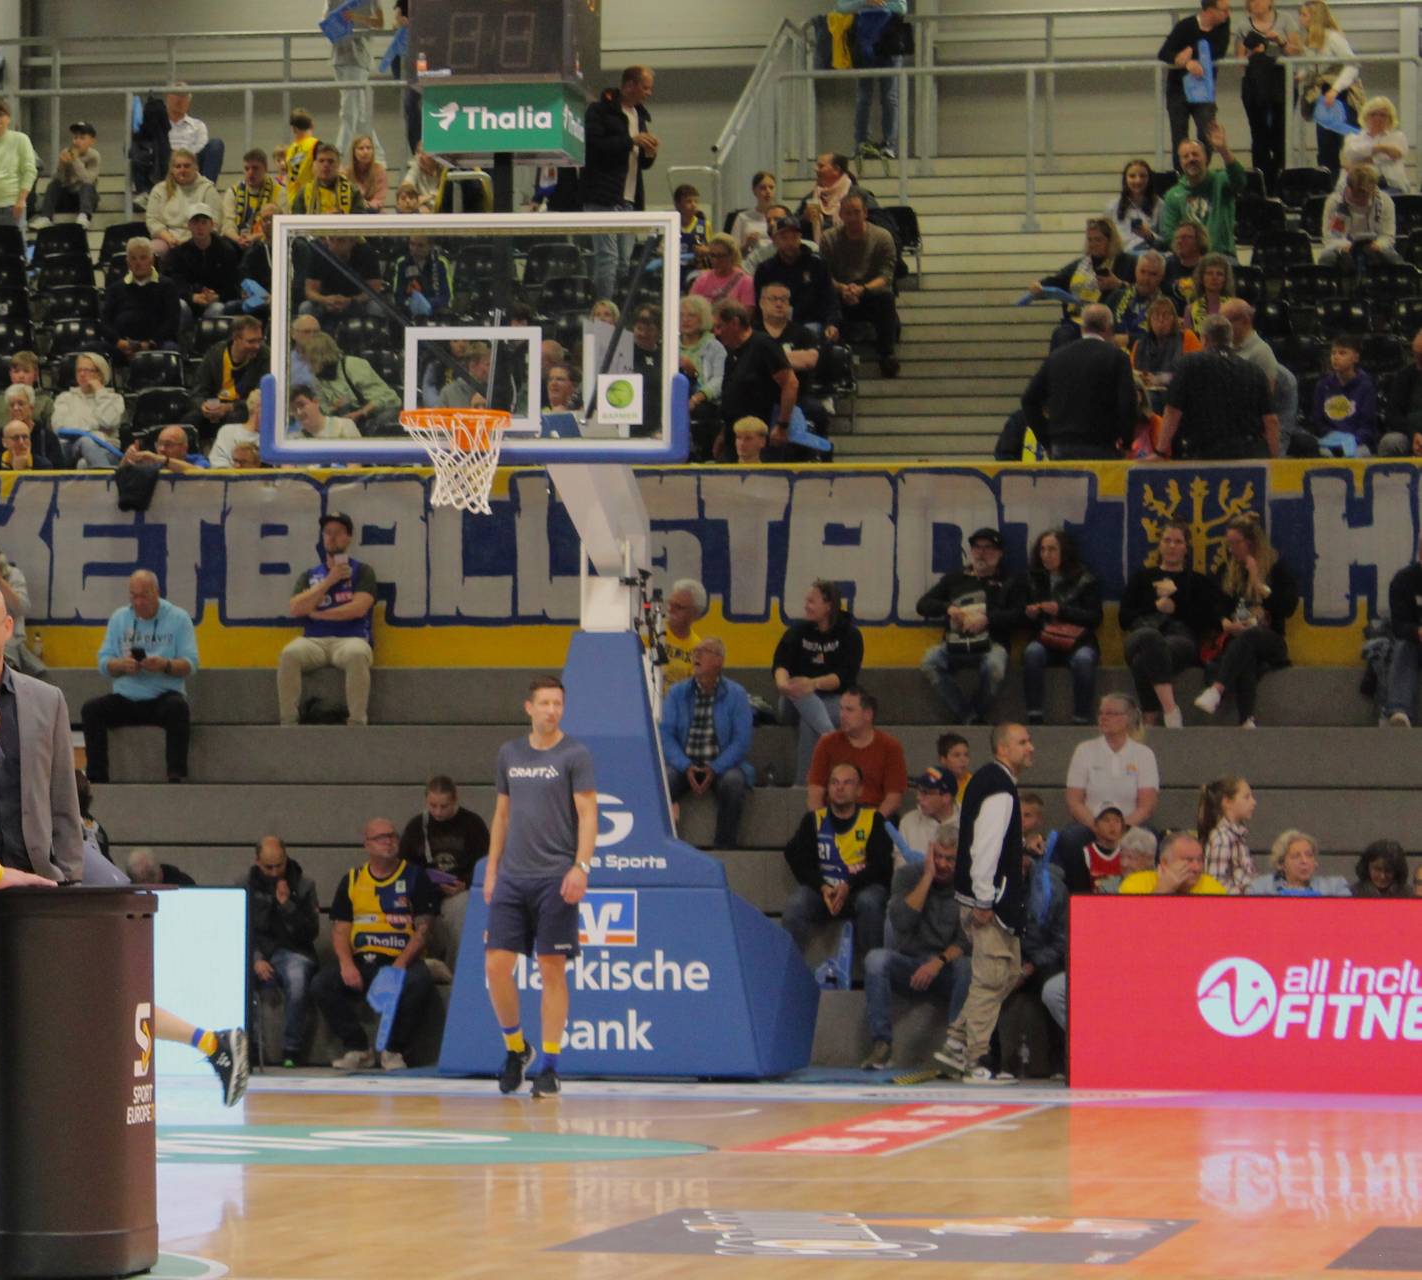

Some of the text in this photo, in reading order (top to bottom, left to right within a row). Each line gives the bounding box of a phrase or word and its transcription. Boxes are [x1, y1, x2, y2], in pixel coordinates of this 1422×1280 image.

[462, 105, 552, 130] Thalia
[1304, 463, 1422, 627] H
[508, 766, 546, 778] CRAFT
[605, 854, 667, 871] Sports
[365, 934, 406, 948] Thalia
[1283, 958, 1329, 994] all
[133, 1084, 153, 1104] SPORT
